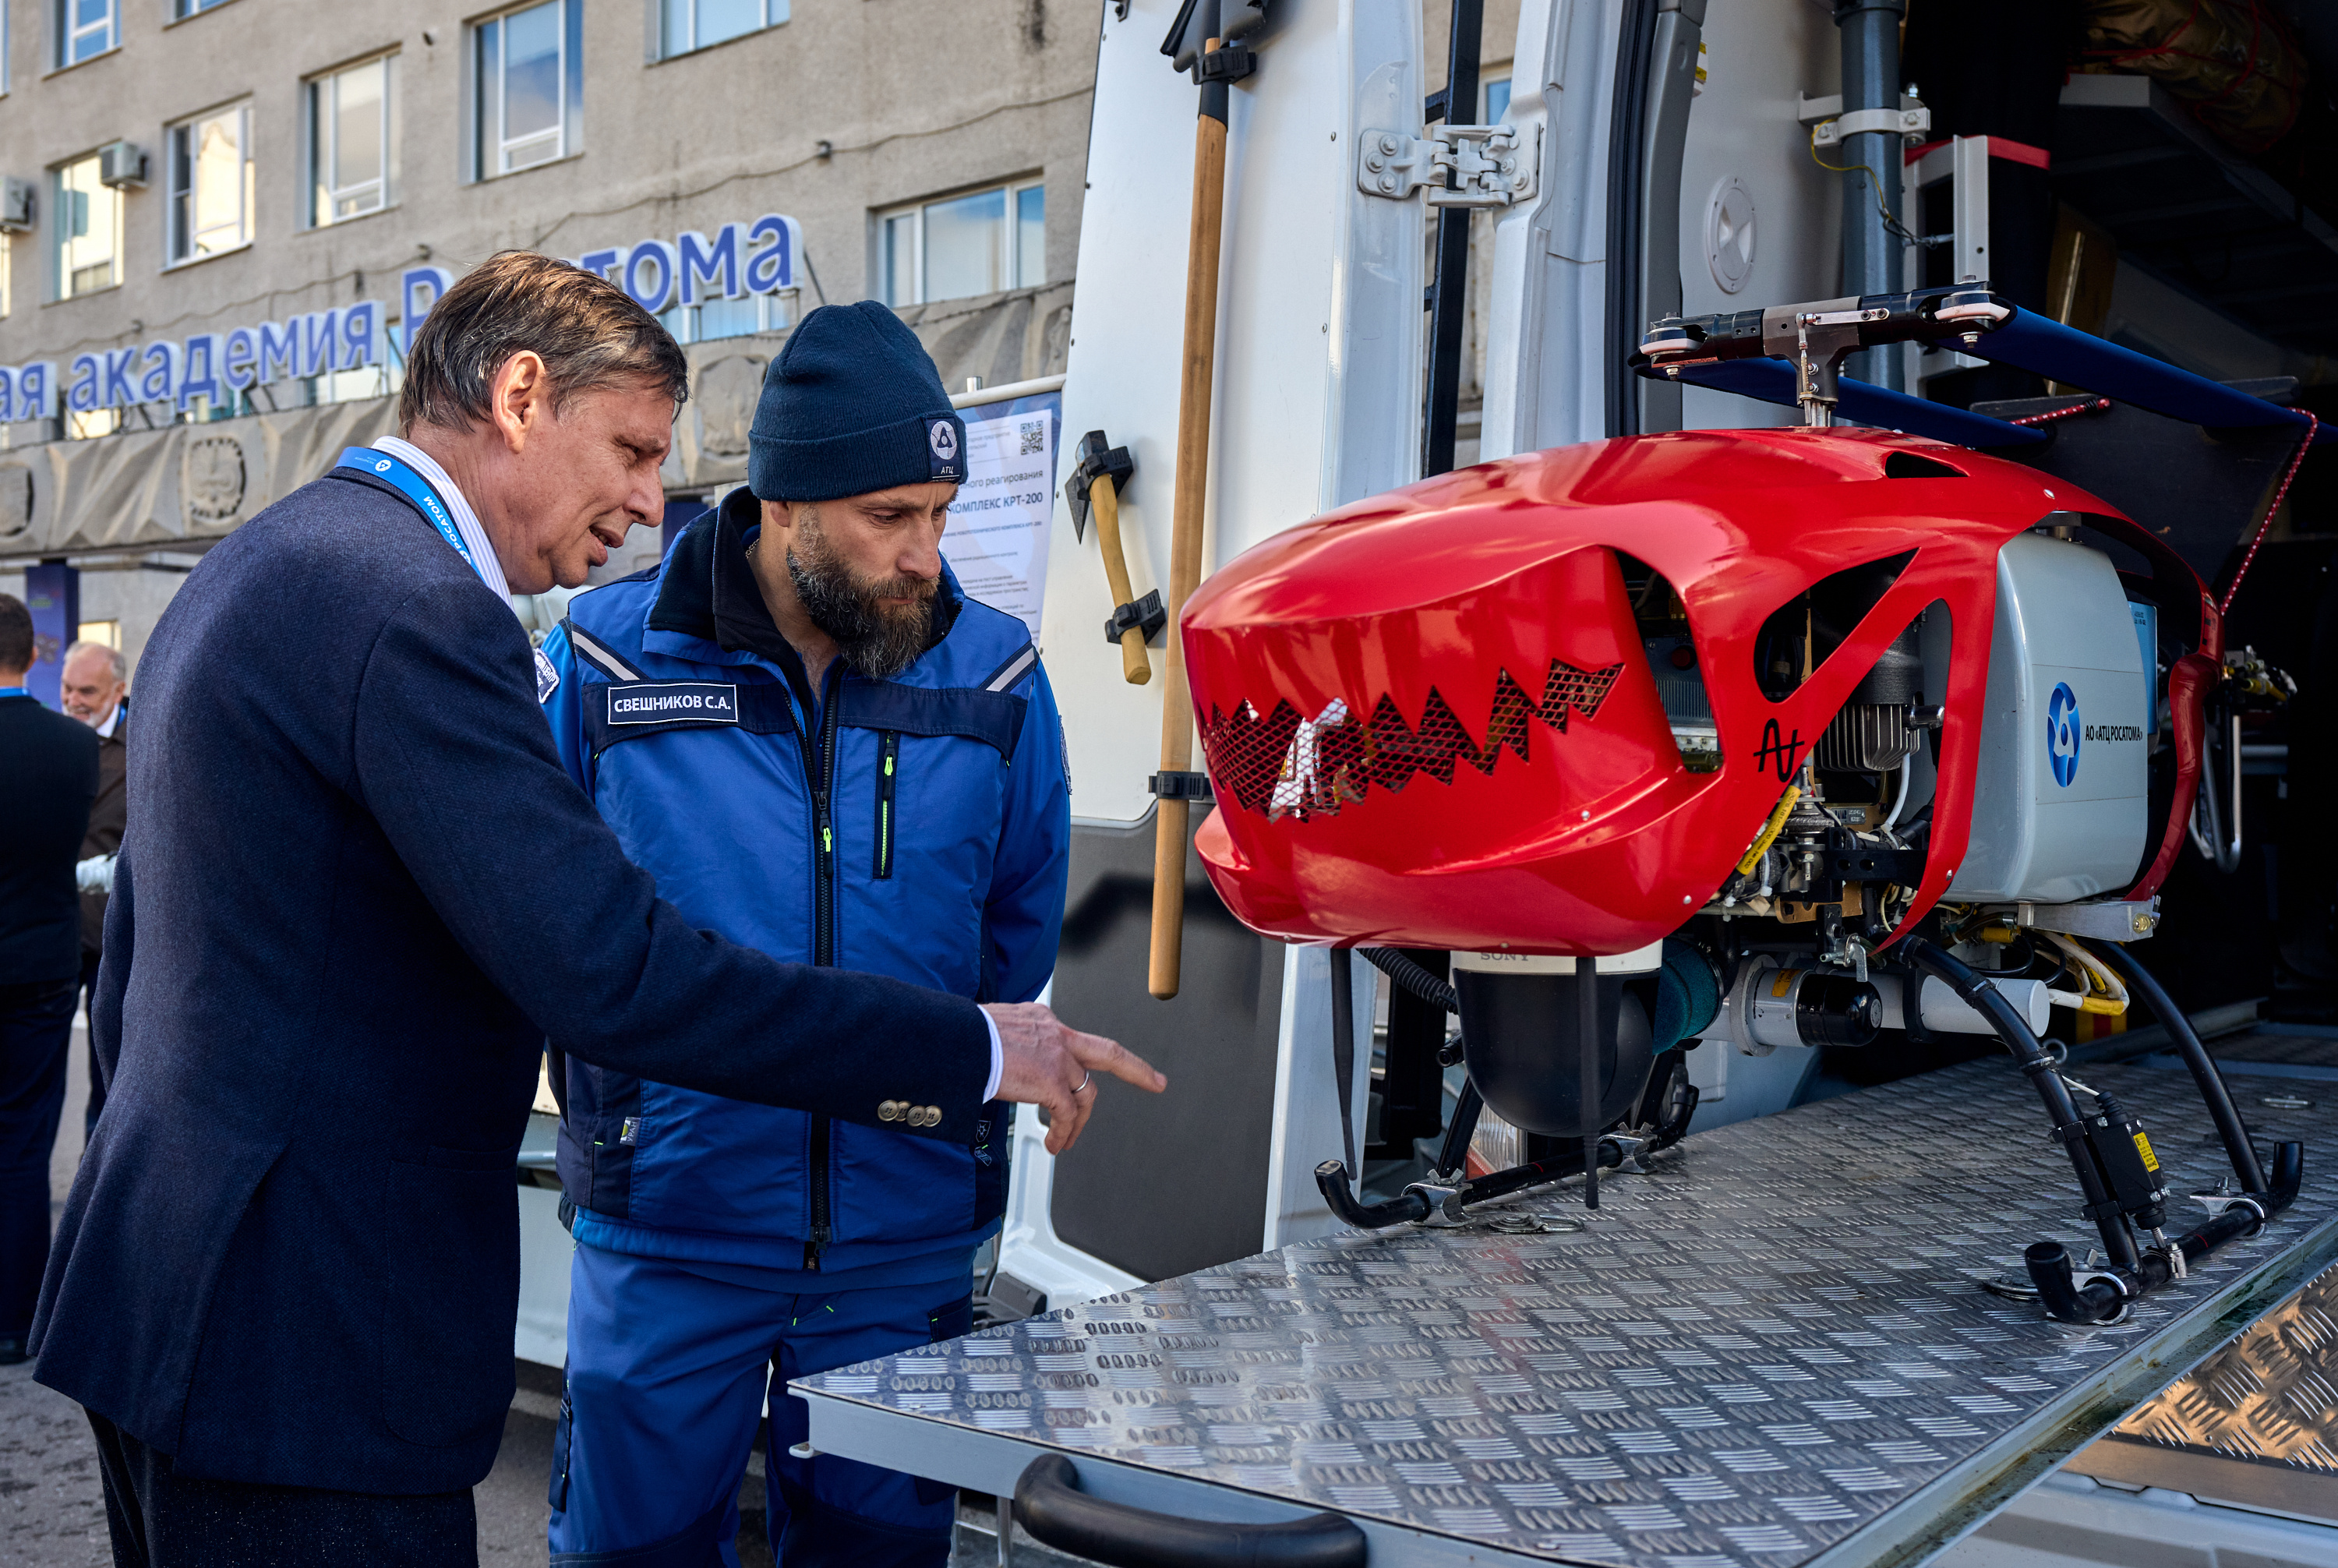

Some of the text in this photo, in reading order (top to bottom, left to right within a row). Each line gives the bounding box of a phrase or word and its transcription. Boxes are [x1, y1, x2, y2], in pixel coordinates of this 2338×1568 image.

[67, 300, 378, 413] академия
[401, 213, 793, 356] Ртома
[940, 466, 954, 475] АТЦ
[986, 470, 1043, 490] реагирования
[949, 492, 1043, 514] КОМПЛЕКС КРТ-200
[423, 496, 461, 549] РОСАТОМ
[614, 695, 732, 712] СВЕШНИКОВ С.А.
[2085, 725, 2143, 744] АО «АТЦ РОСАТОМА»
[1481, 952, 1528, 961] SONY
[627, 1121, 637, 1142] УРАН
